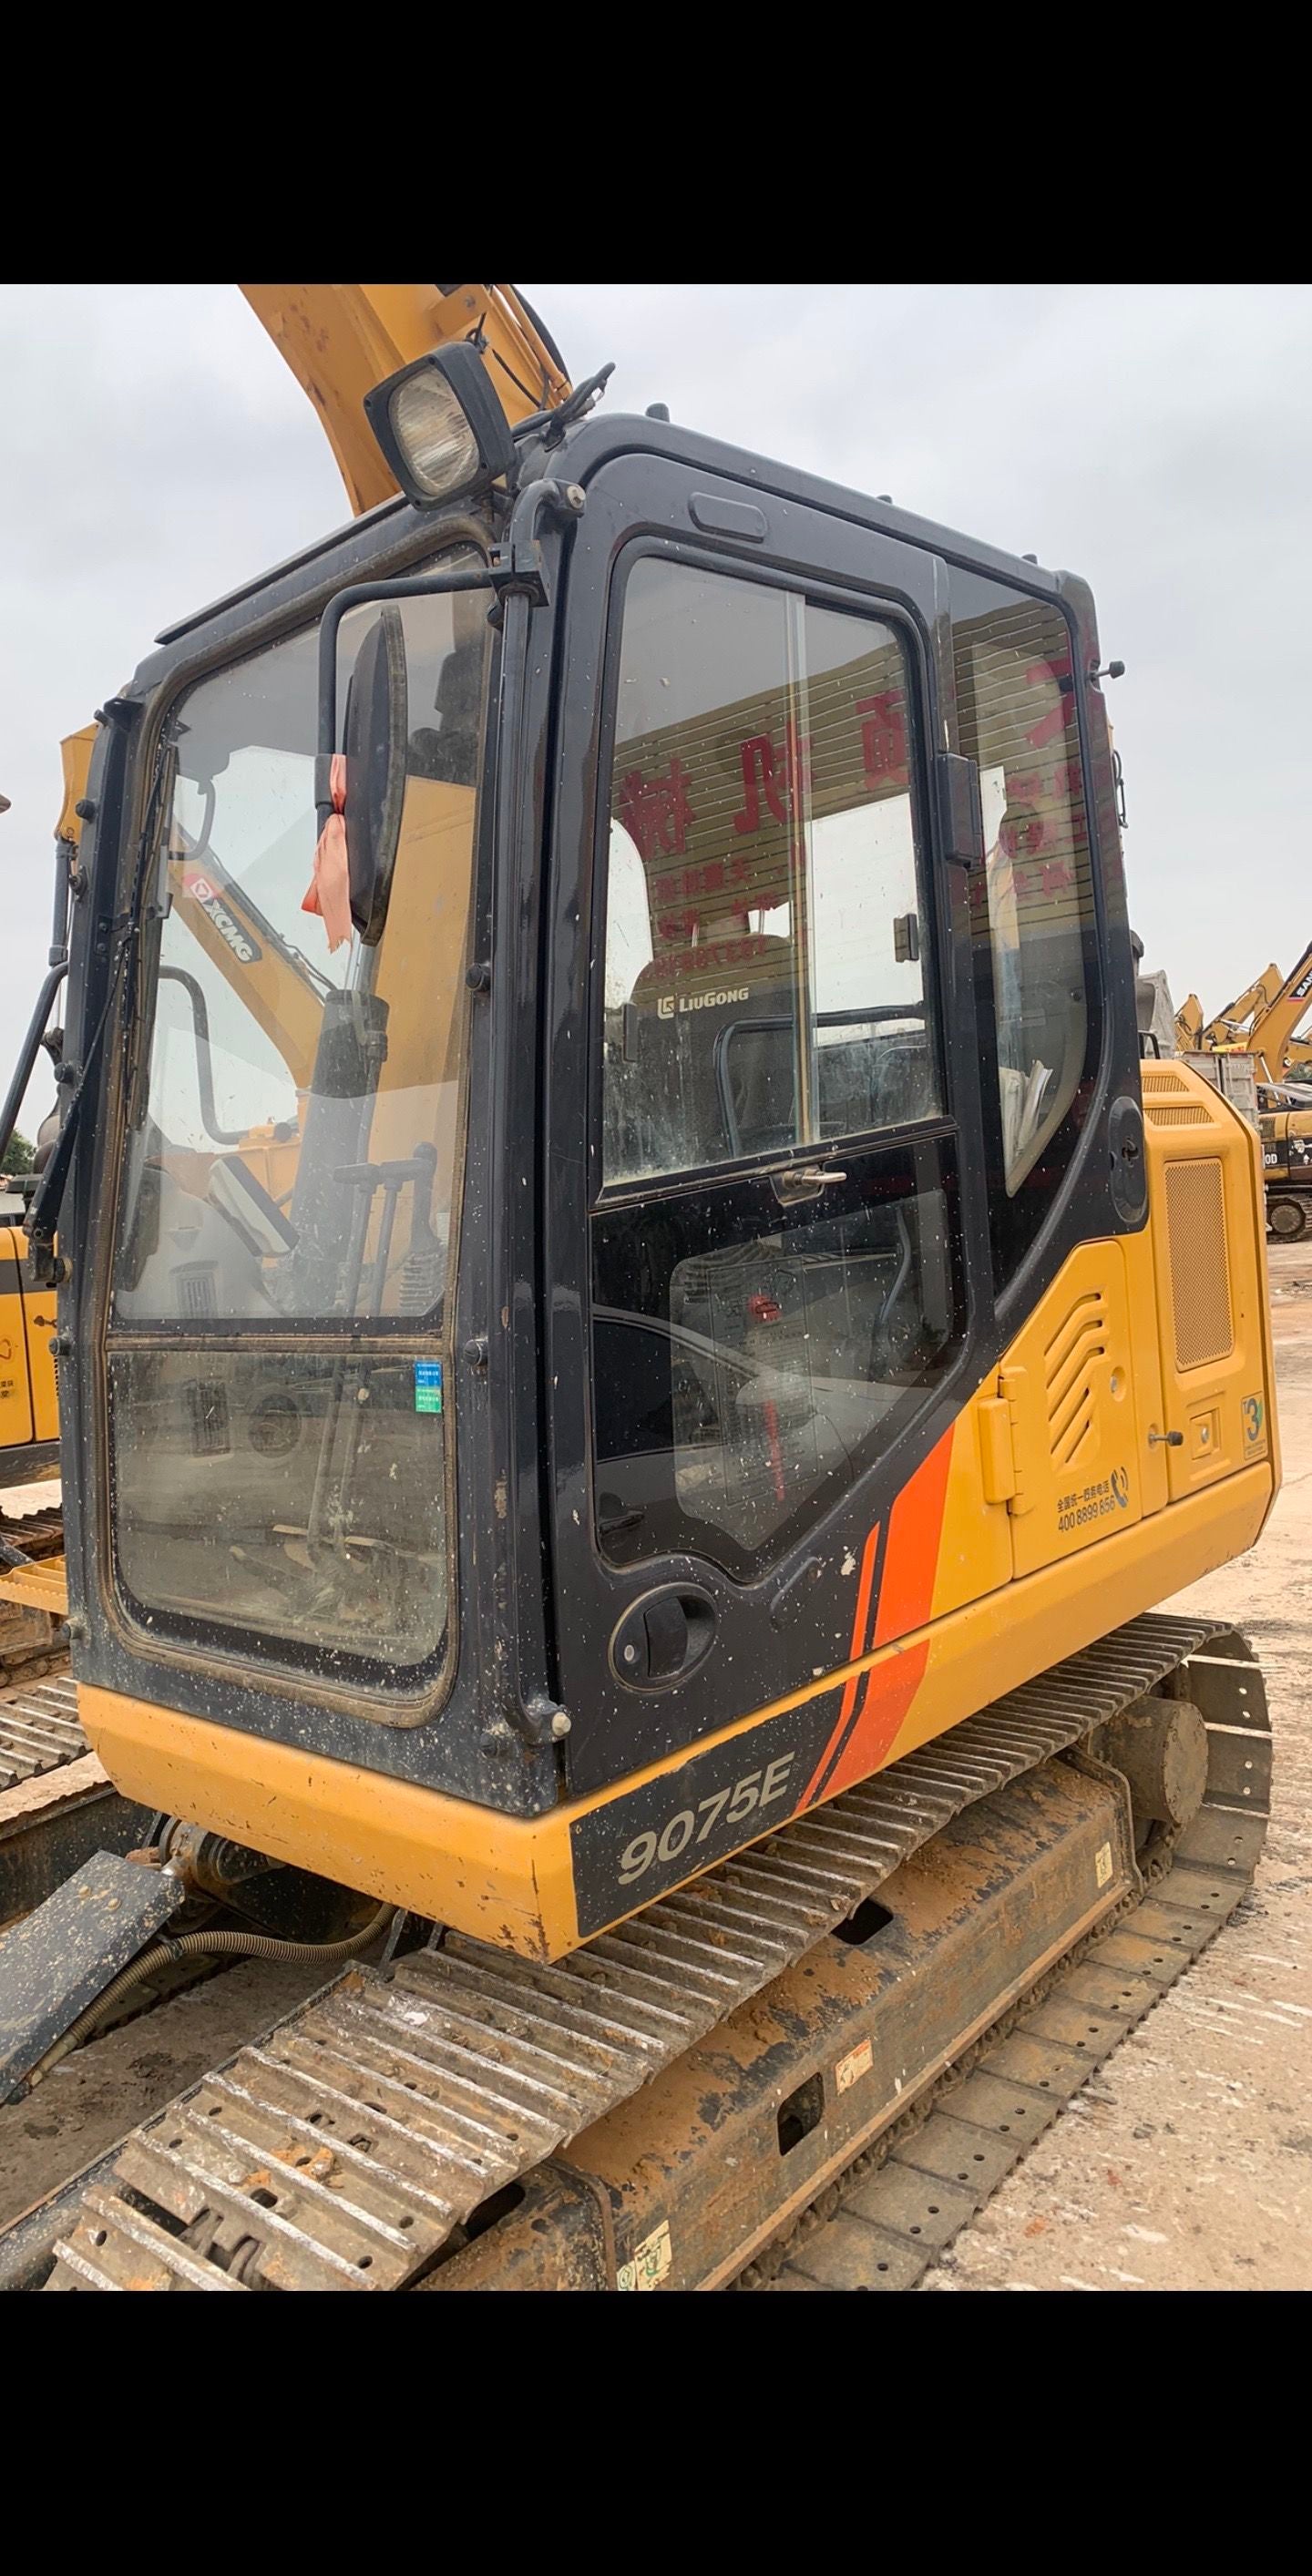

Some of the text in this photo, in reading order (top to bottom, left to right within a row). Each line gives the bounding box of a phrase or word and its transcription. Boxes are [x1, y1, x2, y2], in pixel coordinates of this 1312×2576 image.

[202, 898, 253, 962] XCMG
[1058, 1512, 1075, 1532] 400
[1076, 1502, 1098, 1525] 8899
[618, 1751, 795, 1886] 9075E
